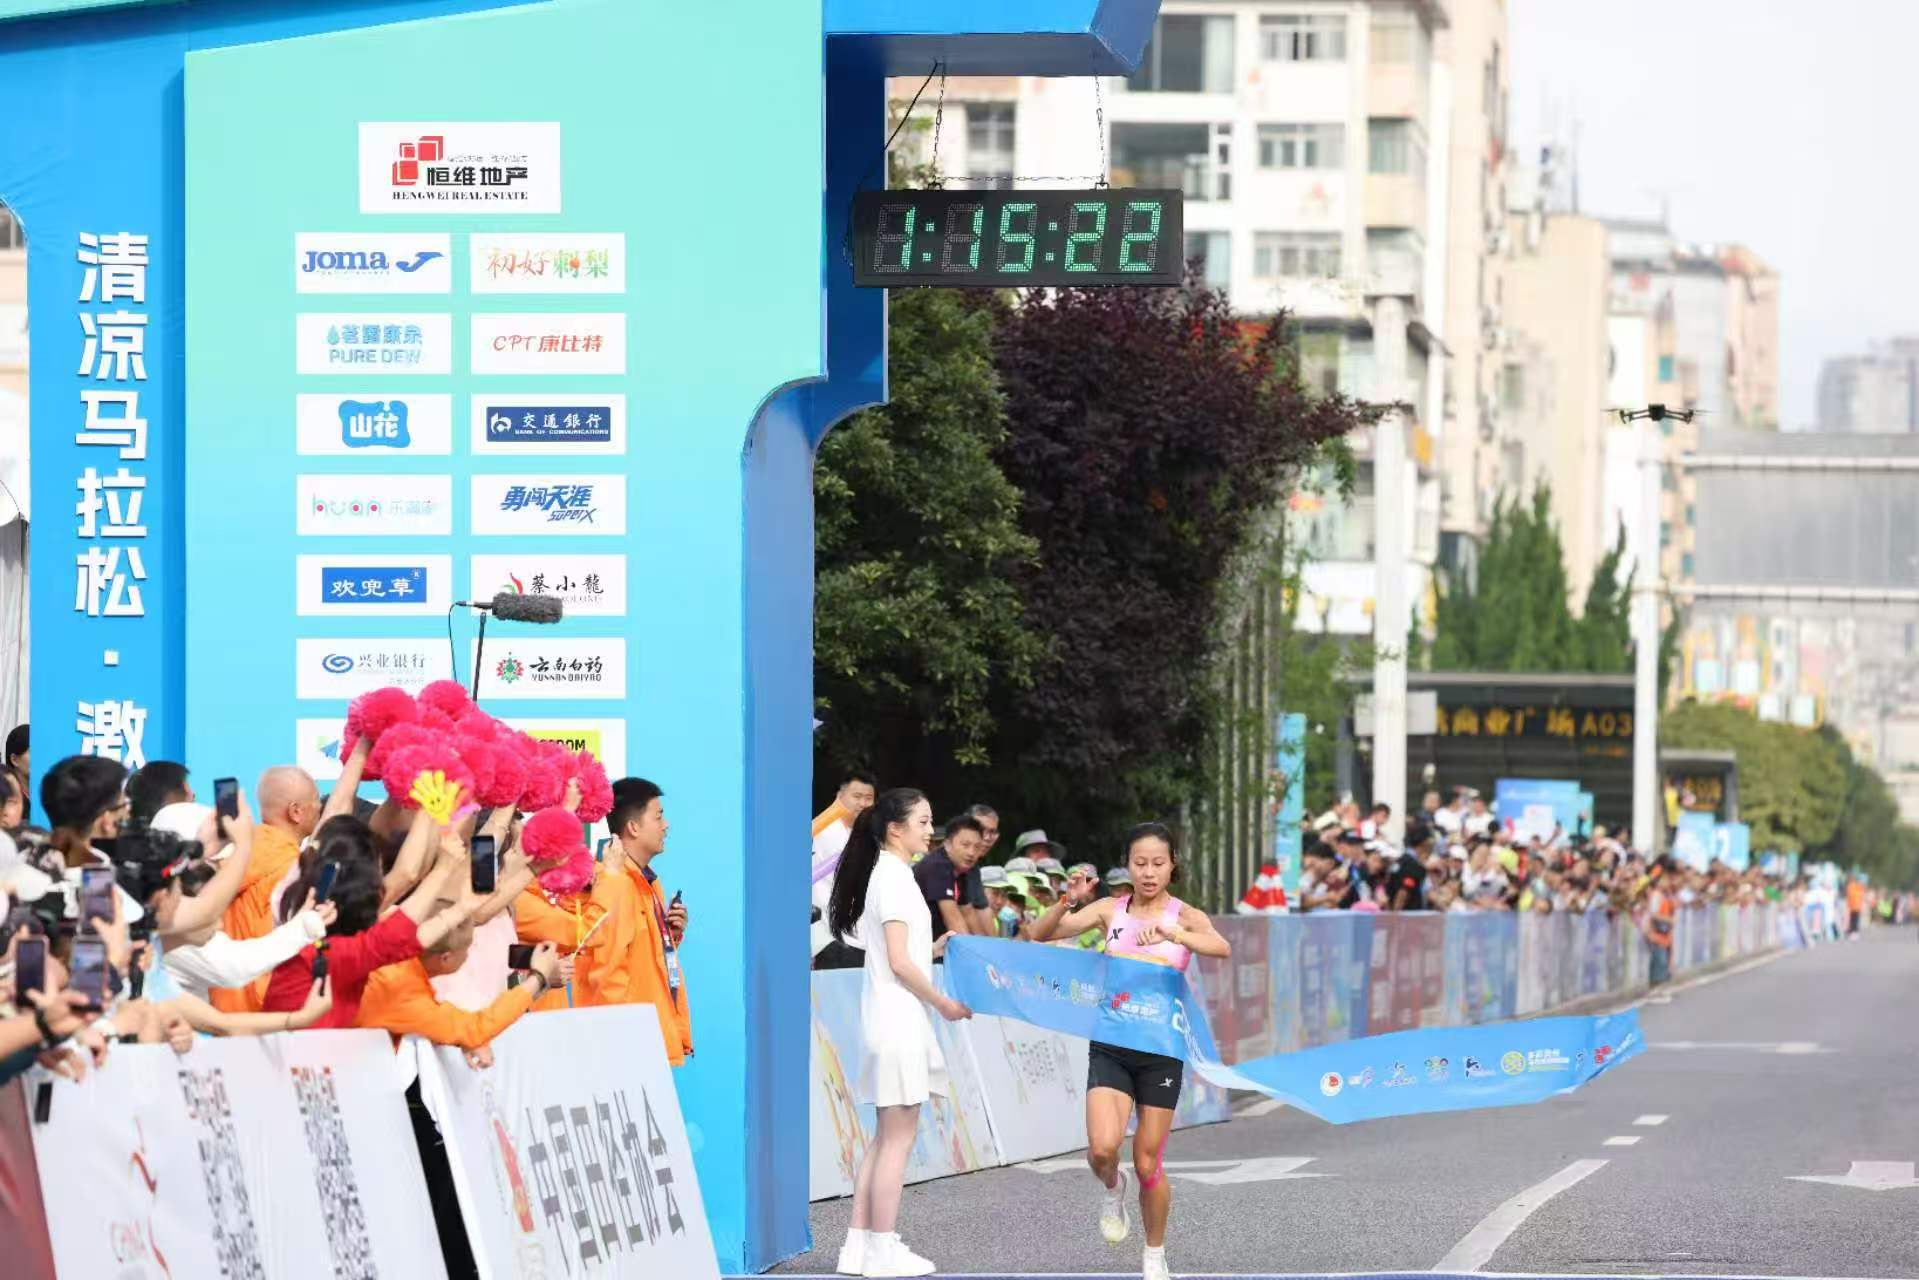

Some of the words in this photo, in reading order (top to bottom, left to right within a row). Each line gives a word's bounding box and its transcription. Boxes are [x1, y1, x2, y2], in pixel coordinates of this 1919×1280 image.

[427, 166, 528, 186] 恒维地产
[392, 191, 449, 200] HENGWEI
[452, 191, 483, 200] REAL
[484, 191, 528, 200] ESTATE
[900, 202, 1162, 273] 1:15:22
[493, 335, 537, 351] CPT
[538, 334, 603, 352] 康比特
[329, 349, 377, 363] PURE
[381, 349, 421, 363] DEW
[349, 412, 399, 438] 山花
[500, 485, 594, 511] 勇闯天涯
[358, 653, 424, 668] 兴业银行
[529, 656, 603, 673] 云南白药
[526, 1083, 686, 1276] 中国田径协会
